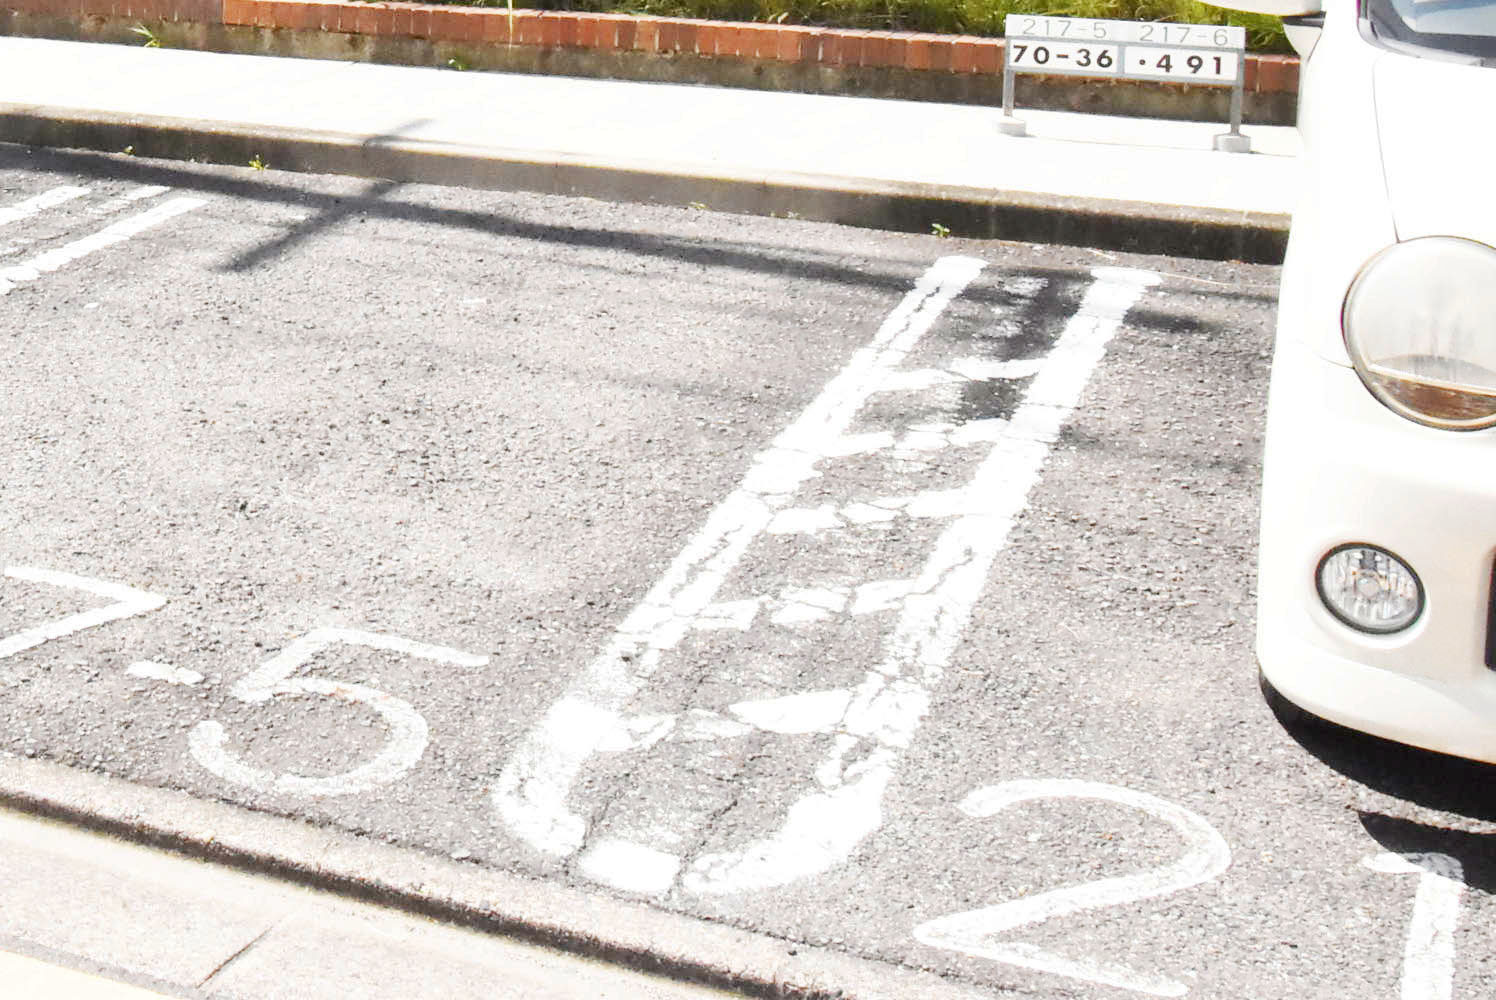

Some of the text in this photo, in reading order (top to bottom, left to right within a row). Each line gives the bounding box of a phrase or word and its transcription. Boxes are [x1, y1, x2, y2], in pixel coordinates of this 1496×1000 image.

[1022, 18, 1108, 38] 217-5
[1139, 24, 1229, 46] 217-6
[1012, 44, 1113, 68] 70-36
